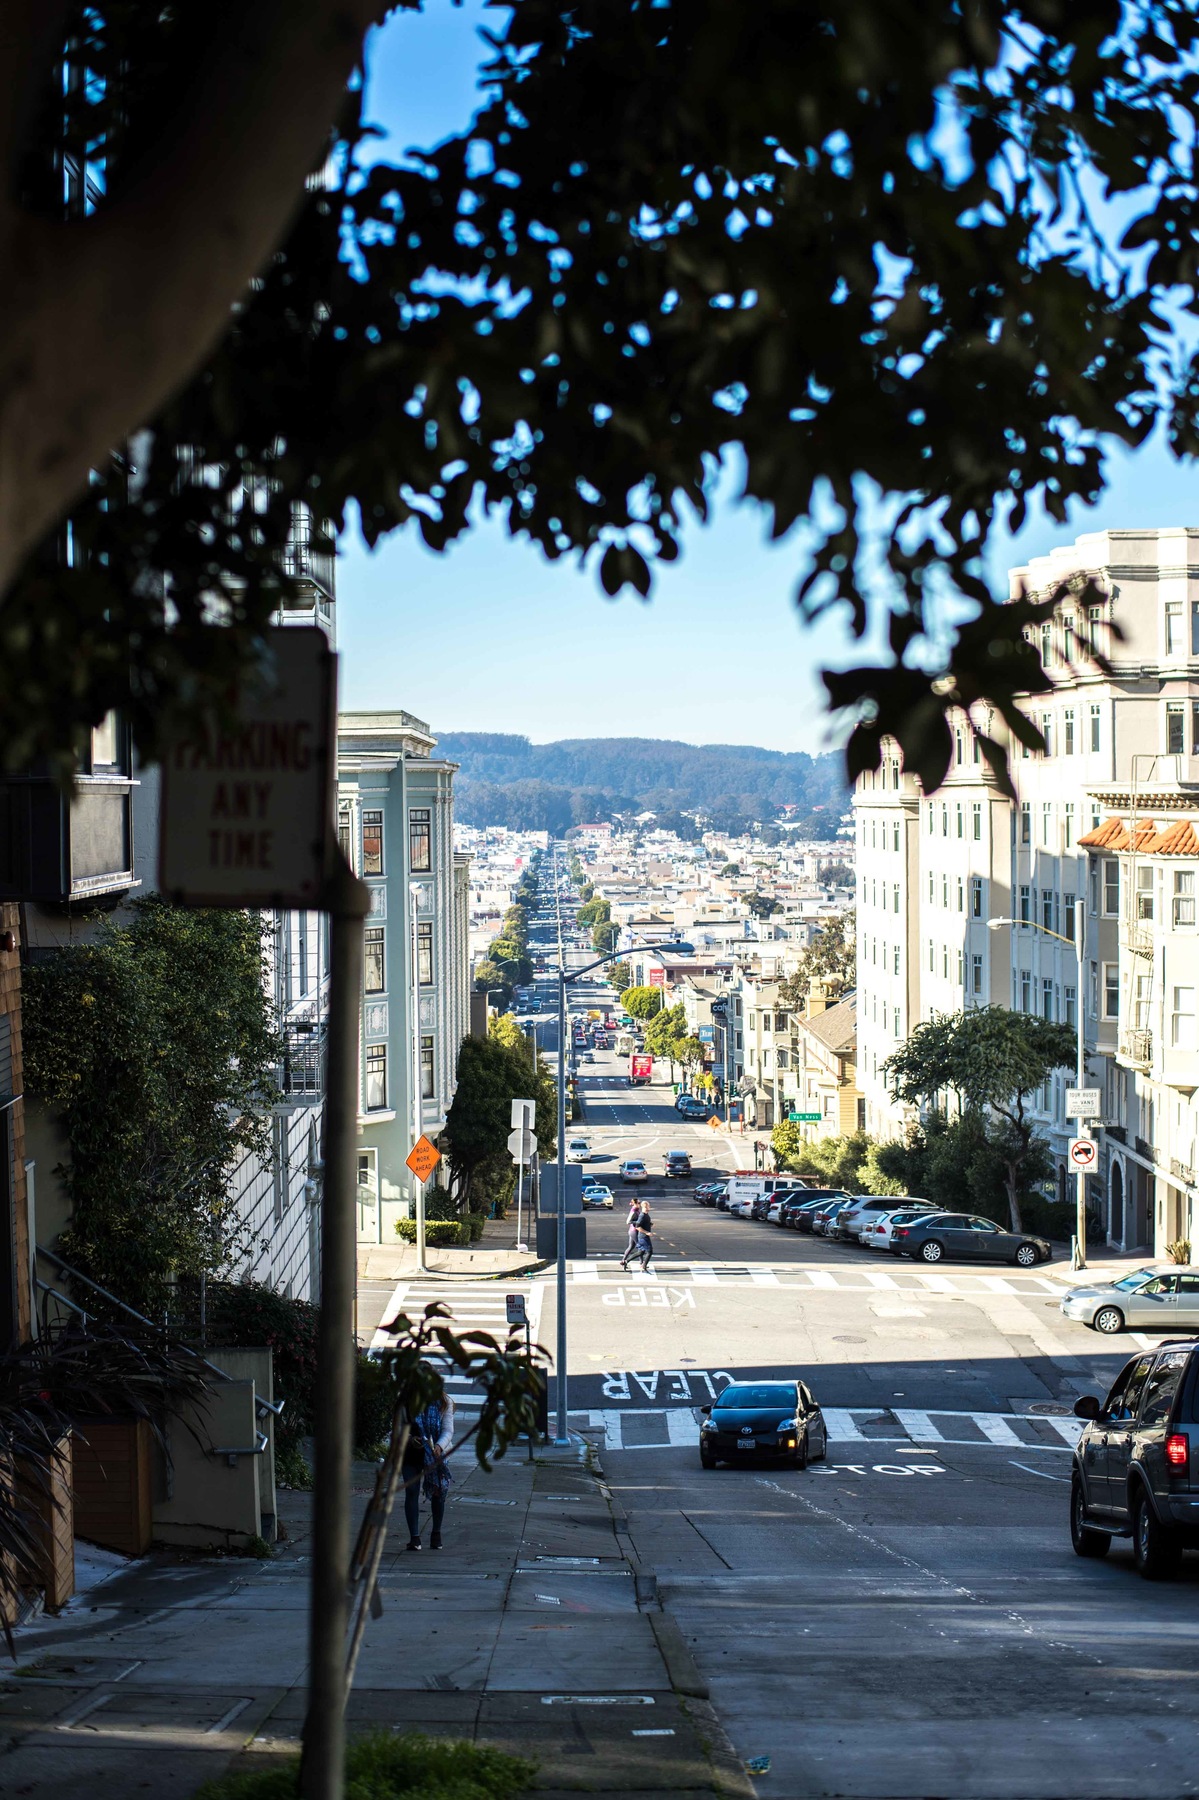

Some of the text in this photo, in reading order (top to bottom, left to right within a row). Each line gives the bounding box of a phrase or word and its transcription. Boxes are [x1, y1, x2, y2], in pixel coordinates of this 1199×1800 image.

[172, 719, 311, 772] PARKING
[210, 781, 273, 820] ANY
[207, 828, 274, 870] TIME
[416, 1146, 430, 1154] ROAD
[415, 1163, 431, 1171] AHEAD
[416, 1155, 430, 1163] WORK
[601, 1287, 697, 1308] KEEP
[806, 1464, 947, 1476] STOP
